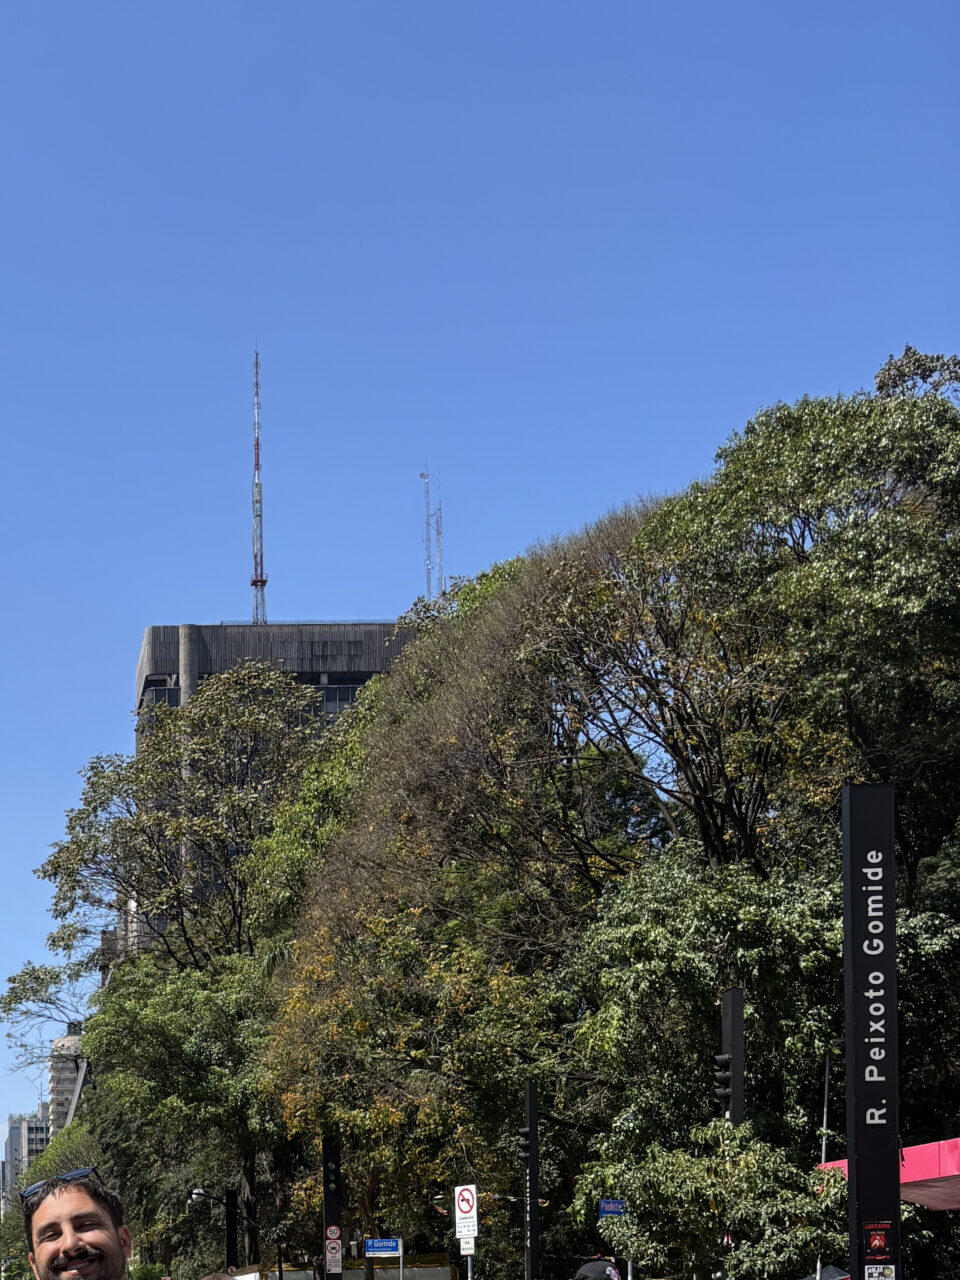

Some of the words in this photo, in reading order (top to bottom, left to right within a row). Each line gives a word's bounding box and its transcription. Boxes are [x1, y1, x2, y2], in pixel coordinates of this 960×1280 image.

[862, 850, 885, 955] Gomide
[864, 971, 886, 1082] Peixoto
[865, 1099, 887, 1124] R.
